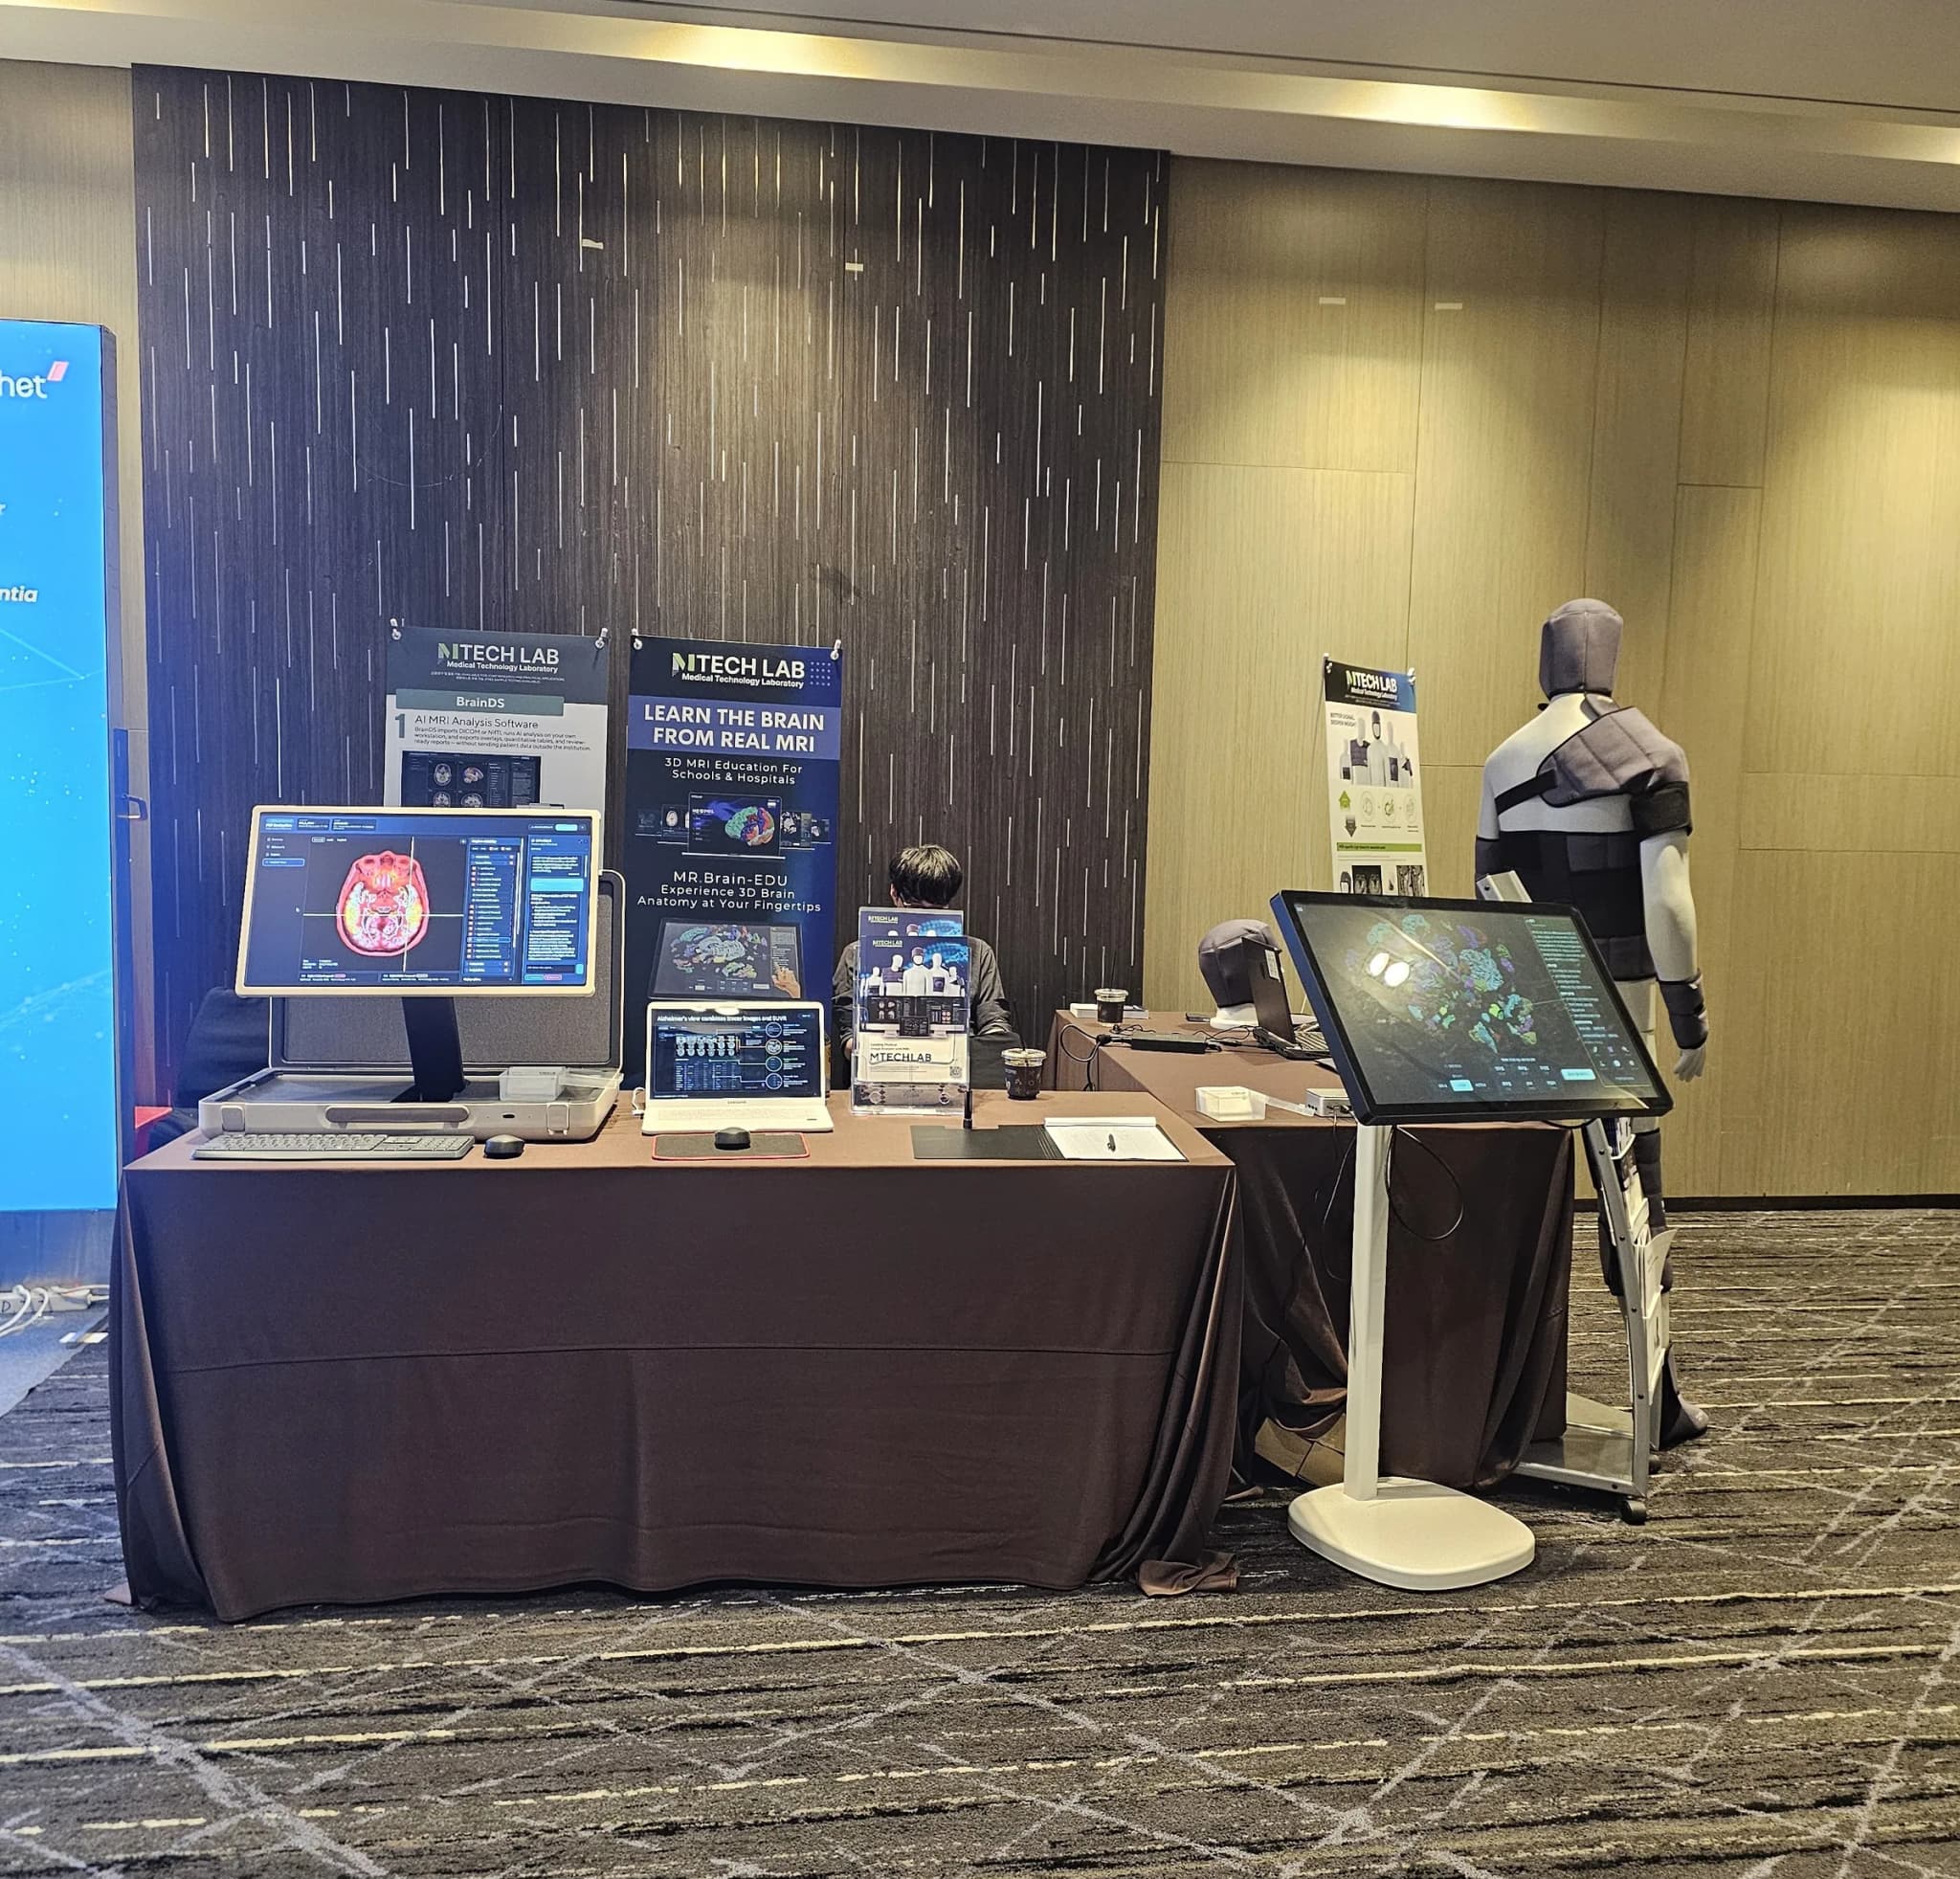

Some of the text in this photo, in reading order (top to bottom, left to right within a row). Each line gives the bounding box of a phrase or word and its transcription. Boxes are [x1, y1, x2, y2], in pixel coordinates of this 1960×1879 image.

[520, 647, 560, 665] LAB
[446, 660, 559, 674] Medical Technology Laboratory
[762, 660, 806, 679] LAB
[681, 673, 805, 689] Medical Technology Laboratory
[1380, 676, 1397, 693] LAB
[456, 696, 505, 708] BrainDS
[414, 715, 539, 728] AI MRI Analysis Software
[644, 704, 825, 731] LEARN THE BRAIN
[394, 713, 406, 739] 1
[653, 727, 814, 752] FROM REAL MRI
[664, 757, 803, 773] 3D MRI Education For
[672, 770, 795, 785] Schools & Hospitals
[660, 884, 795, 899] Experience 3D Brain
[636, 895, 821, 913] Anatomy at Your Fingertips
[870, 1053, 932, 1063] MTECHLAB
